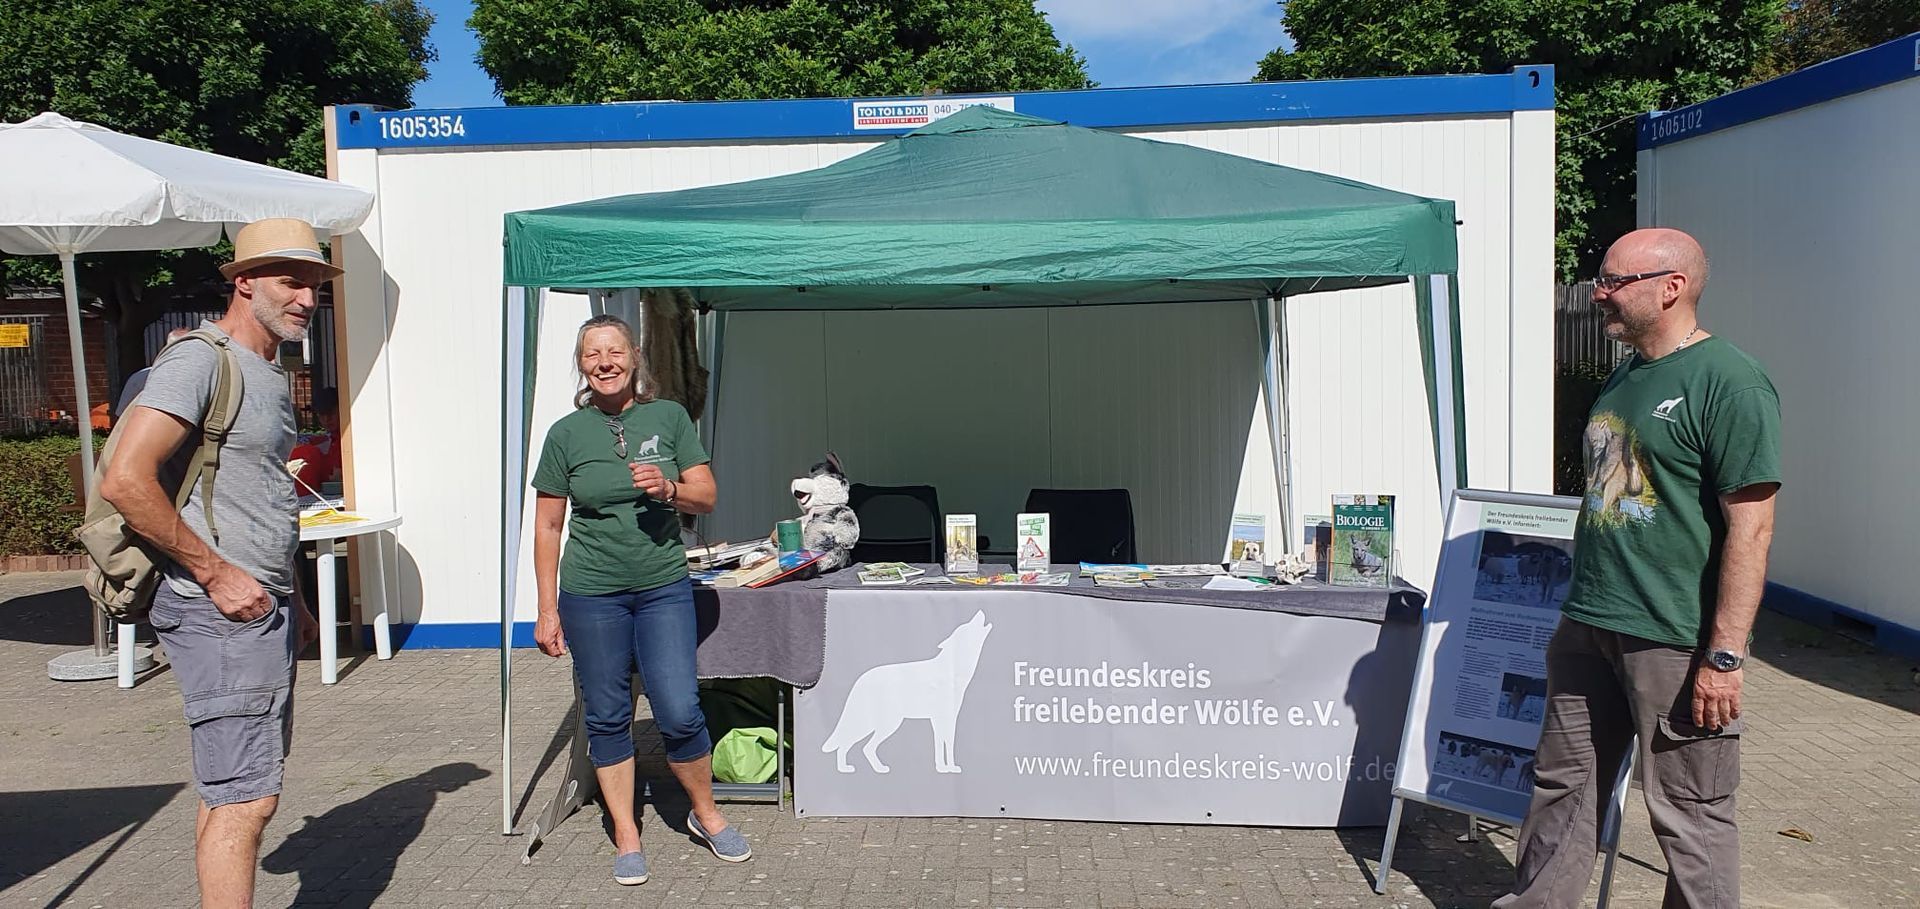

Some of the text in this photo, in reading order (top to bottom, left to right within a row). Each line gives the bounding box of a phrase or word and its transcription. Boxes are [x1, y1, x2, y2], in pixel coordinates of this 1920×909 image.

[859, 106, 927, 116] TOI TOI & DIXI
[934, 105, 951, 114] 040
[379, 115, 466, 139] 1605354
[1651, 109, 1702, 140] 1605102
[1336, 514, 1385, 527] BIOLOGIE
[1013, 661, 1212, 689] Freundeskreis
[1013, 696, 1341, 727] freilebender Wölfe e.V.
[1014, 752, 1396, 782] www.freundeskreis-wolf.de
